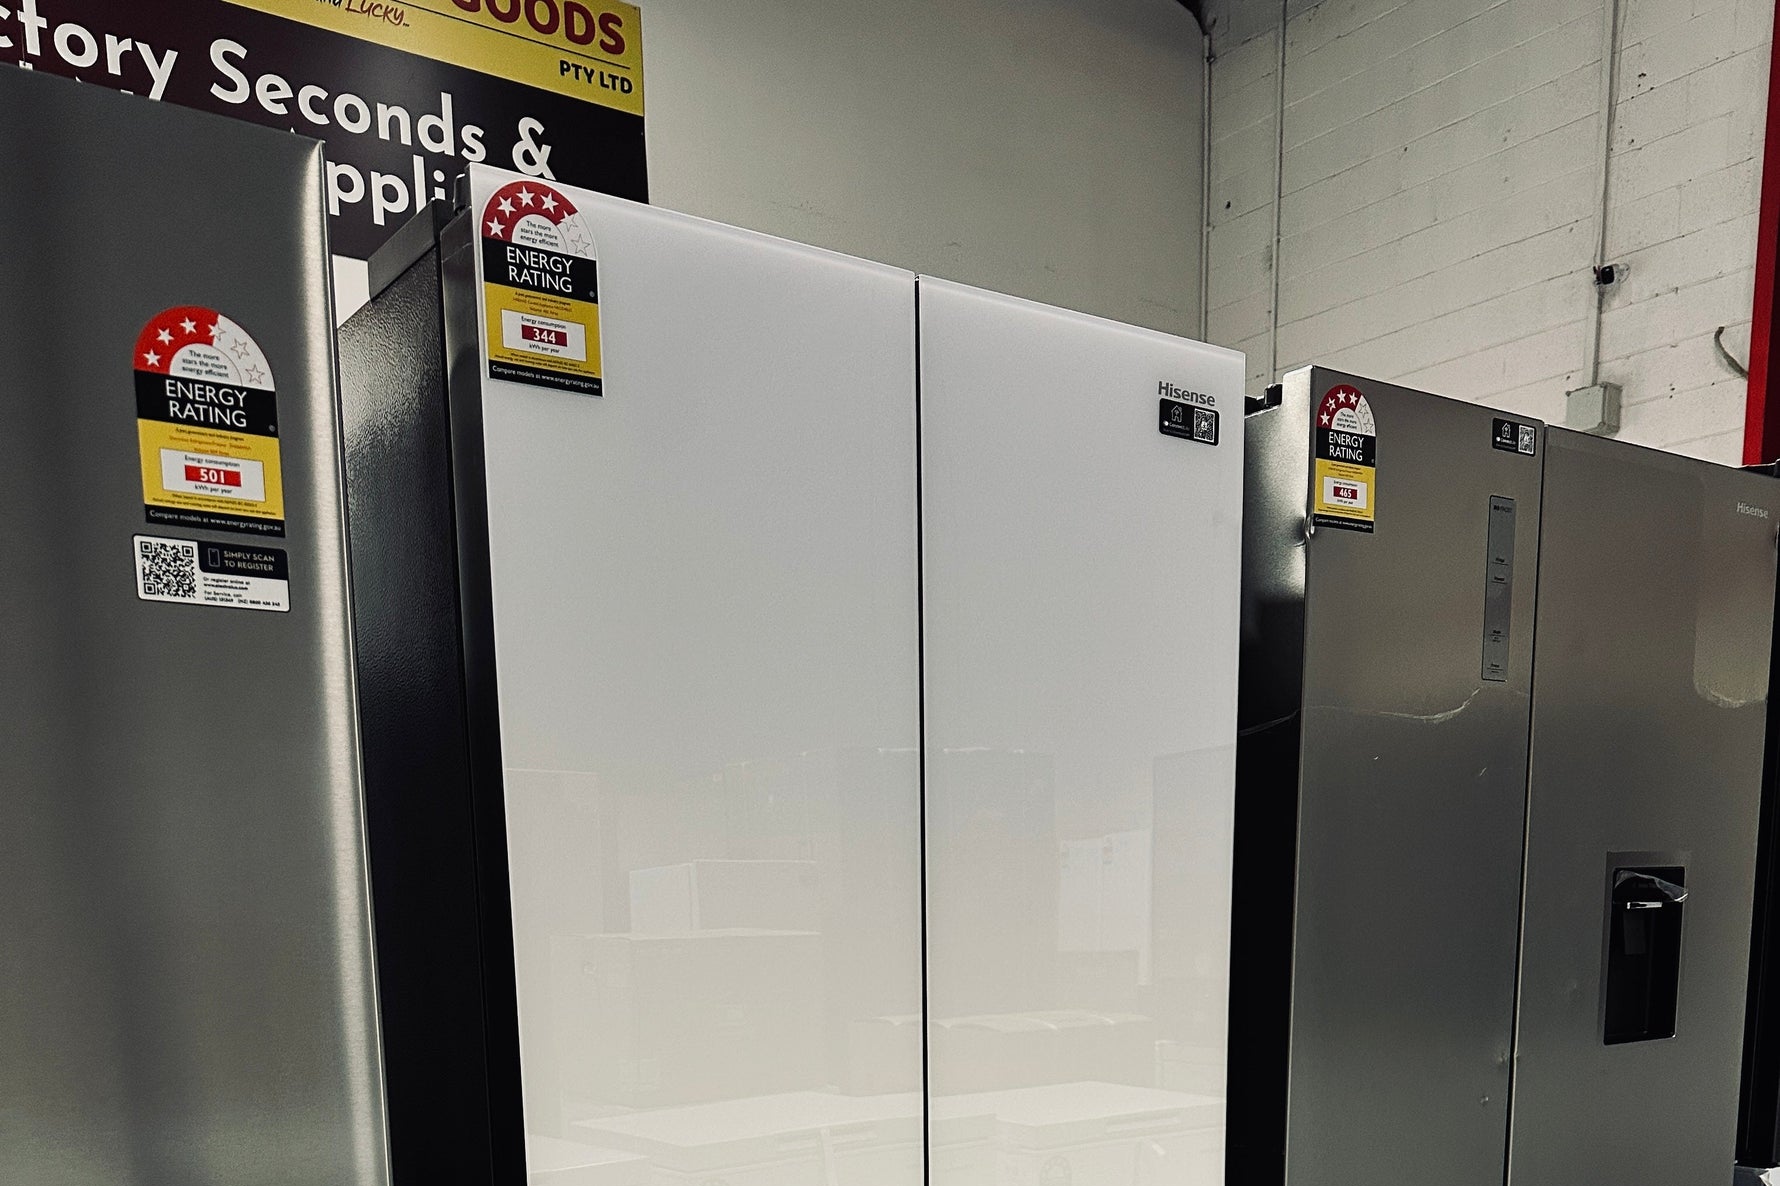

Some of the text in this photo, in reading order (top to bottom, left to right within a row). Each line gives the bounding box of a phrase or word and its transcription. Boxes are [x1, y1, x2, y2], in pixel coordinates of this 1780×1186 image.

[450, 0, 626, 55] OODS
[560, 60, 633, 94] PTY LTD
[209, 38, 556, 180] Seconds &
[506, 246, 573, 274] ENERGY
[509, 266, 573, 293] RATING
[533, 328, 556, 344] 344
[165, 379, 247, 407] ENERGY
[1158, 380, 1215, 406] Hisense
[169, 400, 247, 427] RATING
[1329, 432, 1364, 448] ENERGY
[1329, 445, 1363, 461] RATING
[200, 468, 225, 484] 501
[1340, 488, 1352, 498] 465
[1737, 502, 1768, 519] Hisense
[223, 550, 275, 562] SIMPLY SCAN
[225, 560, 274, 571] TO REGISTER
